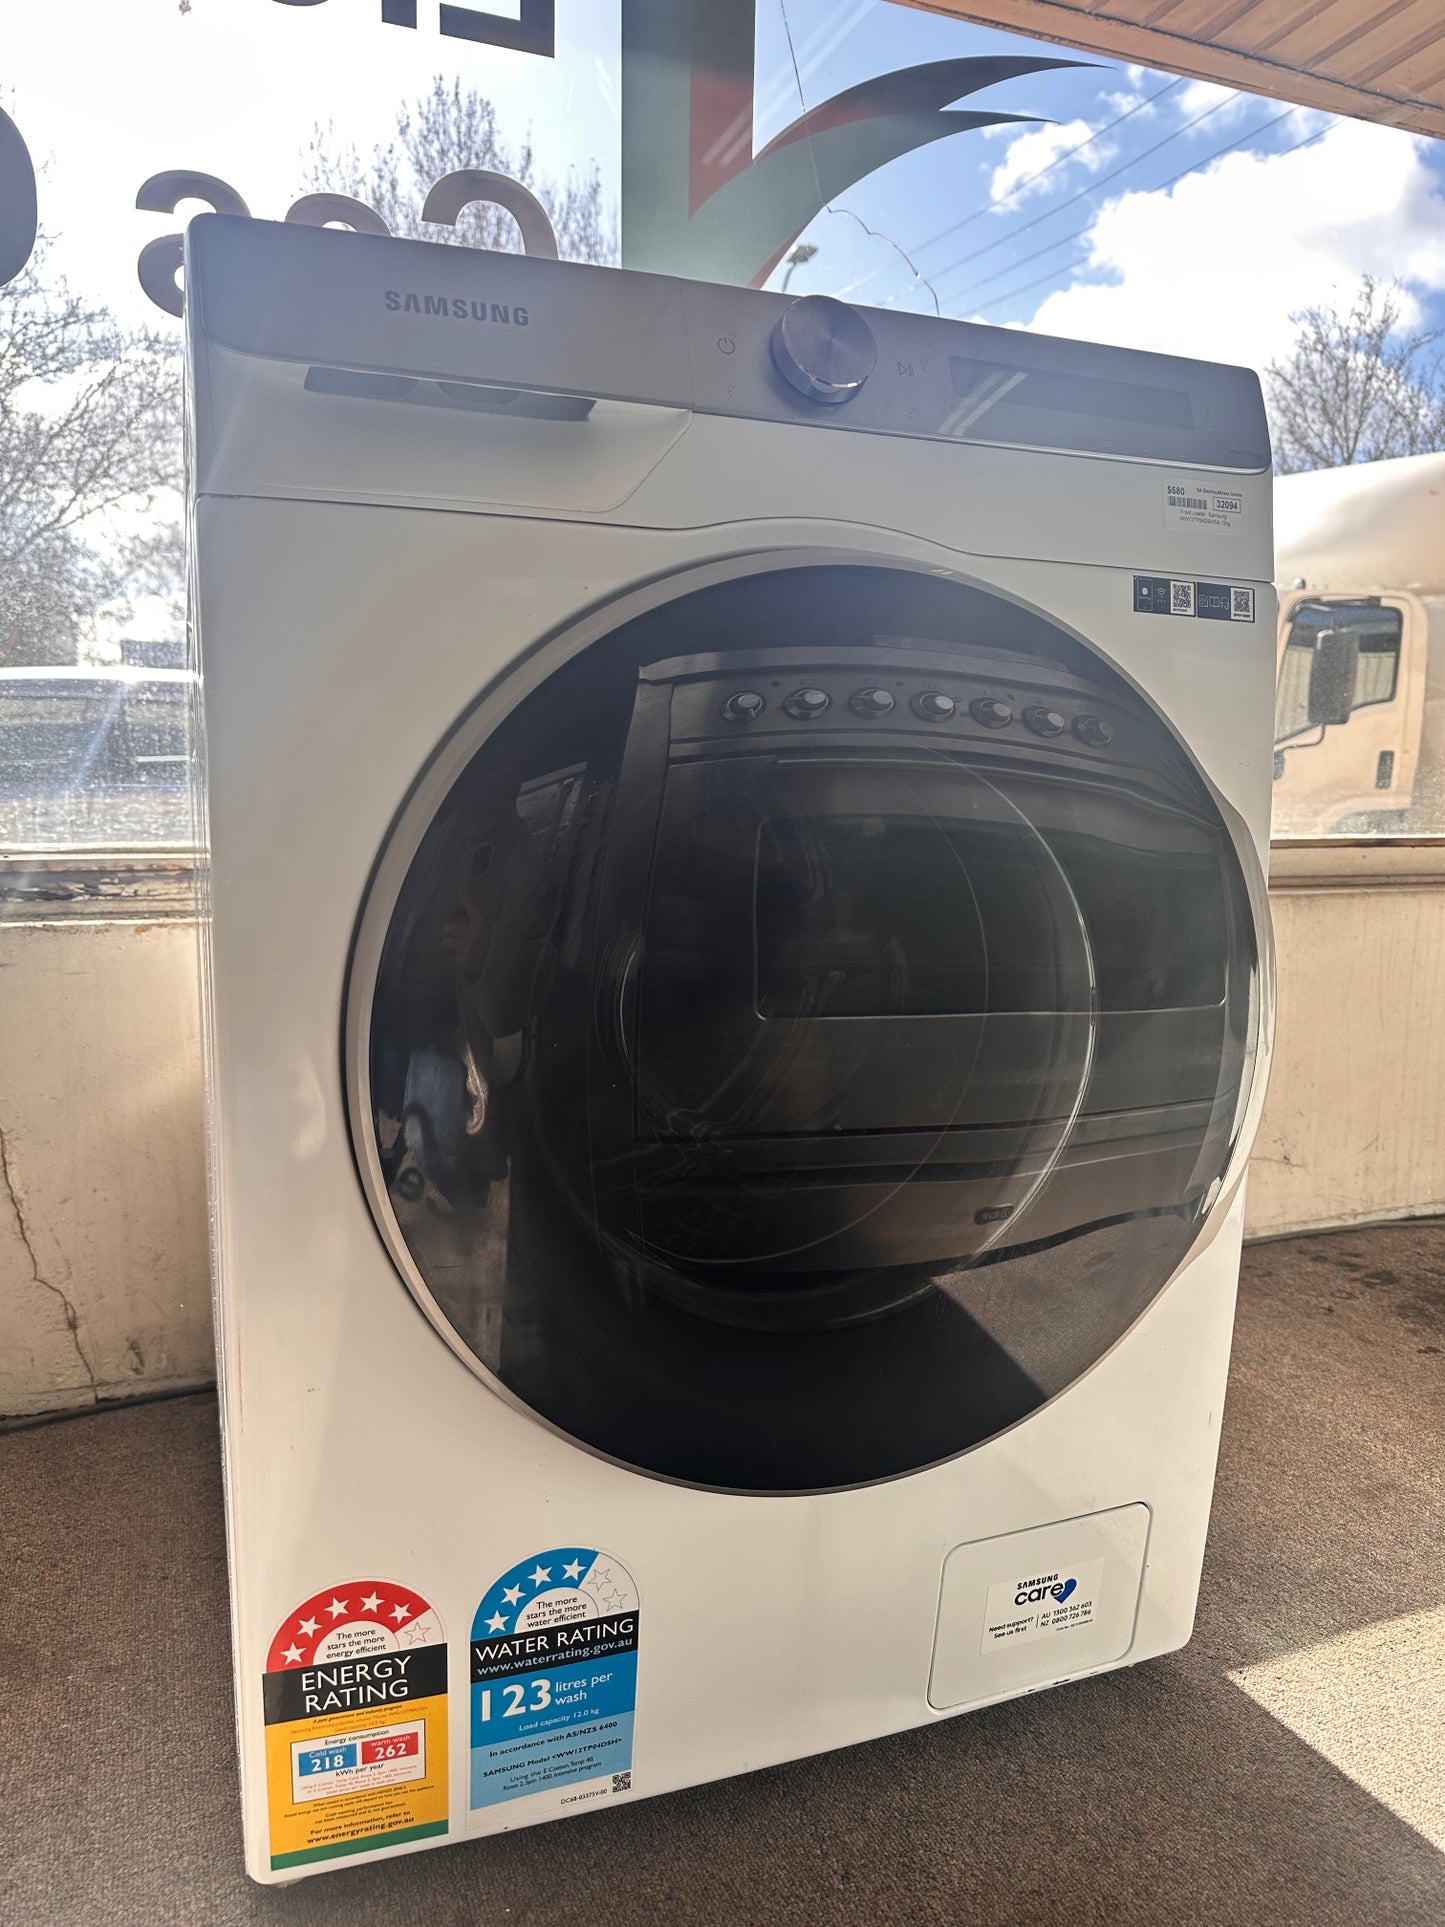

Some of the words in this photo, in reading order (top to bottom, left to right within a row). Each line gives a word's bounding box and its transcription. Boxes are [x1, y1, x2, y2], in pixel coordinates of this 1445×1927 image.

[385, 291, 528, 326] SAMSUNG
[1167, 485, 1185, 496] $680
[1217, 500, 1238, 510] 32094
[1017, 1573, 1059, 1590] SAMSUNG
[1014, 1582, 1064, 1605] care
[526, 1610, 546, 1620] stars
[548, 1608, 563, 1616] the
[564, 1603, 587, 1613] more
[536, 1601, 553, 1609] The
[555, 1597, 577, 1606] more
[1041, 1611, 1051, 1619] AU
[1053, 1607, 1068, 1617] 1300
[1069, 1604, 1080, 1612] 362
[1080, 1600, 1093, 1609] 603
[527, 1618, 551, 1628] water
[554, 1611, 586, 1623] efficient
[989, 1622, 1006, 1633] Need
[1006, 1616, 1034, 1629] support?
[1040, 1620, 1050, 1628] NZ
[1051, 1615, 1068, 1625] 0800
[1068, 1612, 1080, 1620] 726
[1080, 1609, 1092, 1617] 786
[336, 1632, 353, 1640] The
[354, 1629, 376, 1638] more
[476, 1635, 549, 1661] WATER
[557, 1618, 634, 1647] RATING
[994, 1631, 1005, 1639] See
[1014, 1625, 1027, 1634] first
[326, 1649, 354, 1659] energy
[356, 1644, 387, 1655] efficient
[327, 1641, 347, 1651] stars
[348, 1638, 361, 1647] the
[363, 1635, 385, 1644] more
[477, 1638, 633, 1675] www.waterrating.gov.au
[301, 1655, 411, 1691] ENERGY
[305, 1679, 409, 1713] RATING
[481, 1678, 551, 1722] 123
[555, 1678, 587, 1693] litres
[591, 1672, 613, 1688] per
[555, 1690, 587, 1705] wash
[519, 1721, 538, 1731] Load
[540, 1714, 570, 1727] capacity
[573, 1709, 589, 1719] 12.0
[590, 1707, 600, 1716] kg
[325, 1736, 347, 1746] Energy
[348, 1729, 390, 1742] consumption
[371, 1739, 391, 1747] warm
[393, 1735, 411, 1743] wash
[489, 1750, 498, 1758] In
[500, 1740, 545, 1755] accordance
[547, 1734, 565, 1744] with
[565, 1726, 597, 1739] AS/NZS
[599, 1721, 618, 1731] 6400
[309, 1749, 327, 1759] Cold
[328, 1746, 347, 1755] wash
[375, 1743, 407, 1760] 262
[311, 1754, 344, 1772] 218
[335, 1768, 354, 1777] kWh
[355, 1766, 367, 1775] per
[369, 1763, 385, 1772] year
[483, 1761, 526, 1778] SAMSUNG
[527, 1755, 550, 1767] Model
[510, 1773, 529, 1783] Using
[530, 1770, 541, 1778] the
[543, 1767, 548, 1775] E
[570, 1759, 585, 1769] Temp
[578, 1762, 602, 1775] program
[307, 1816, 415, 1844] www.energyrating.gov.au
[324, 1824, 342, 1833] more
[344, 1816, 385, 1829] information,
[385, 1812, 401, 1820] refer
